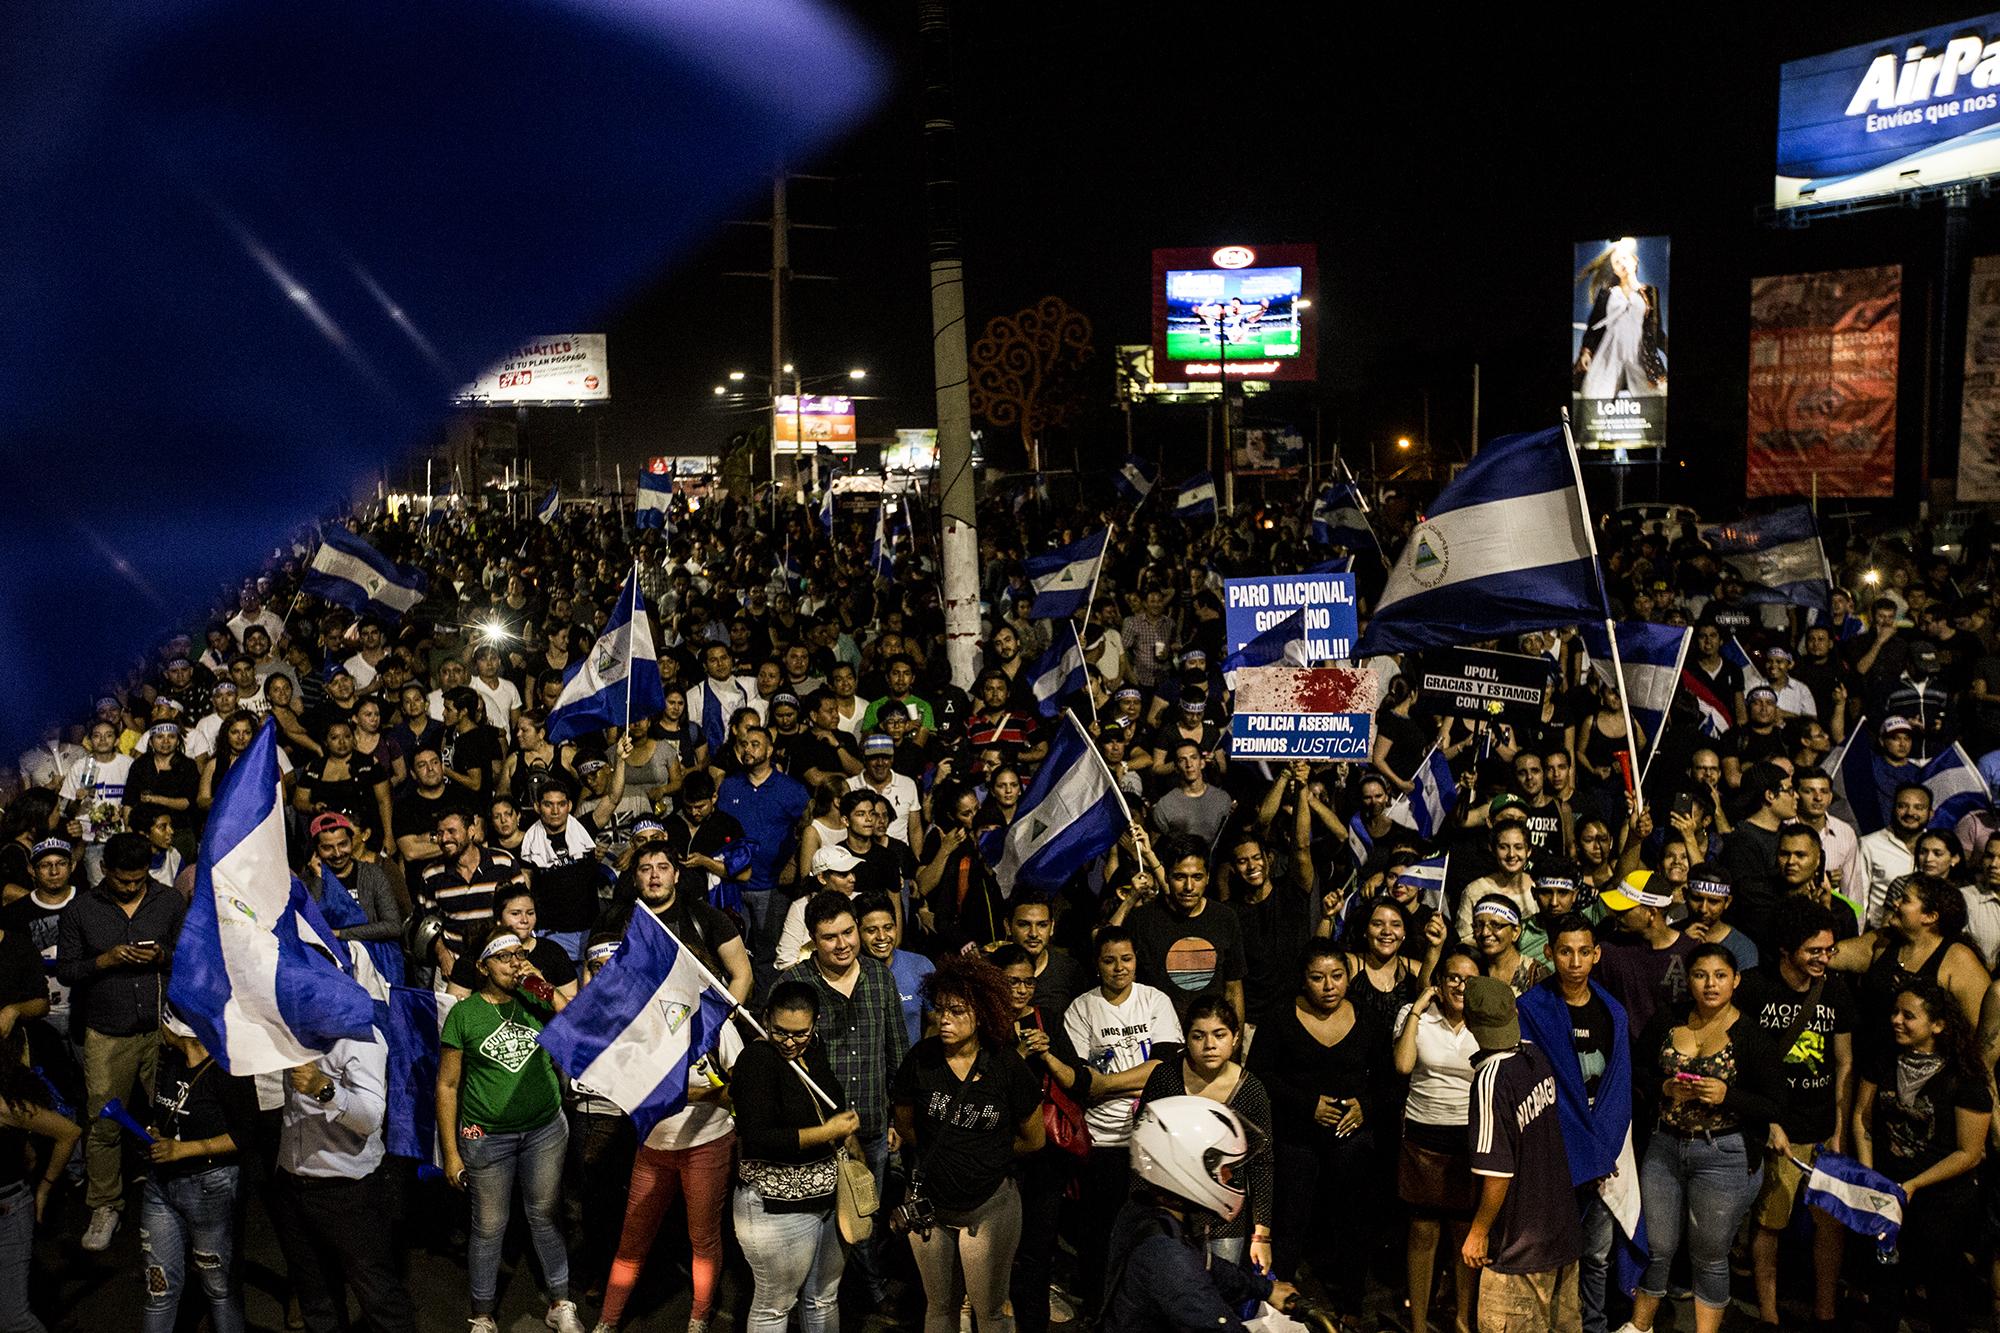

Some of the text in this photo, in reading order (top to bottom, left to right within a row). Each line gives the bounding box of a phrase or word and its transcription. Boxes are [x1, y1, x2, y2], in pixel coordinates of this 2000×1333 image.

[1926, 101, 1960, 124] que
[1963, 93, 1997, 113] nos
[504, 363, 515, 372] DE
[517, 361, 528, 370] TU
[529, 357, 550, 367] PLAN
[1229, 581, 1354, 607] PARO NACIONAL,
[1464, 665, 1499, 682] UPOLI,
[1426, 677, 1539, 702] GRACIAS Y ESTAMOS
[1456, 696, 1479, 710] CON
[1248, 716, 1354, 734] POLICIA ASESINA,
[1232, 737, 1367, 753] PEDIMOS JUSTICIA
[1761, 1003, 1836, 1020] MODRN
[1122, 1023, 1149, 1037] MUEVE
